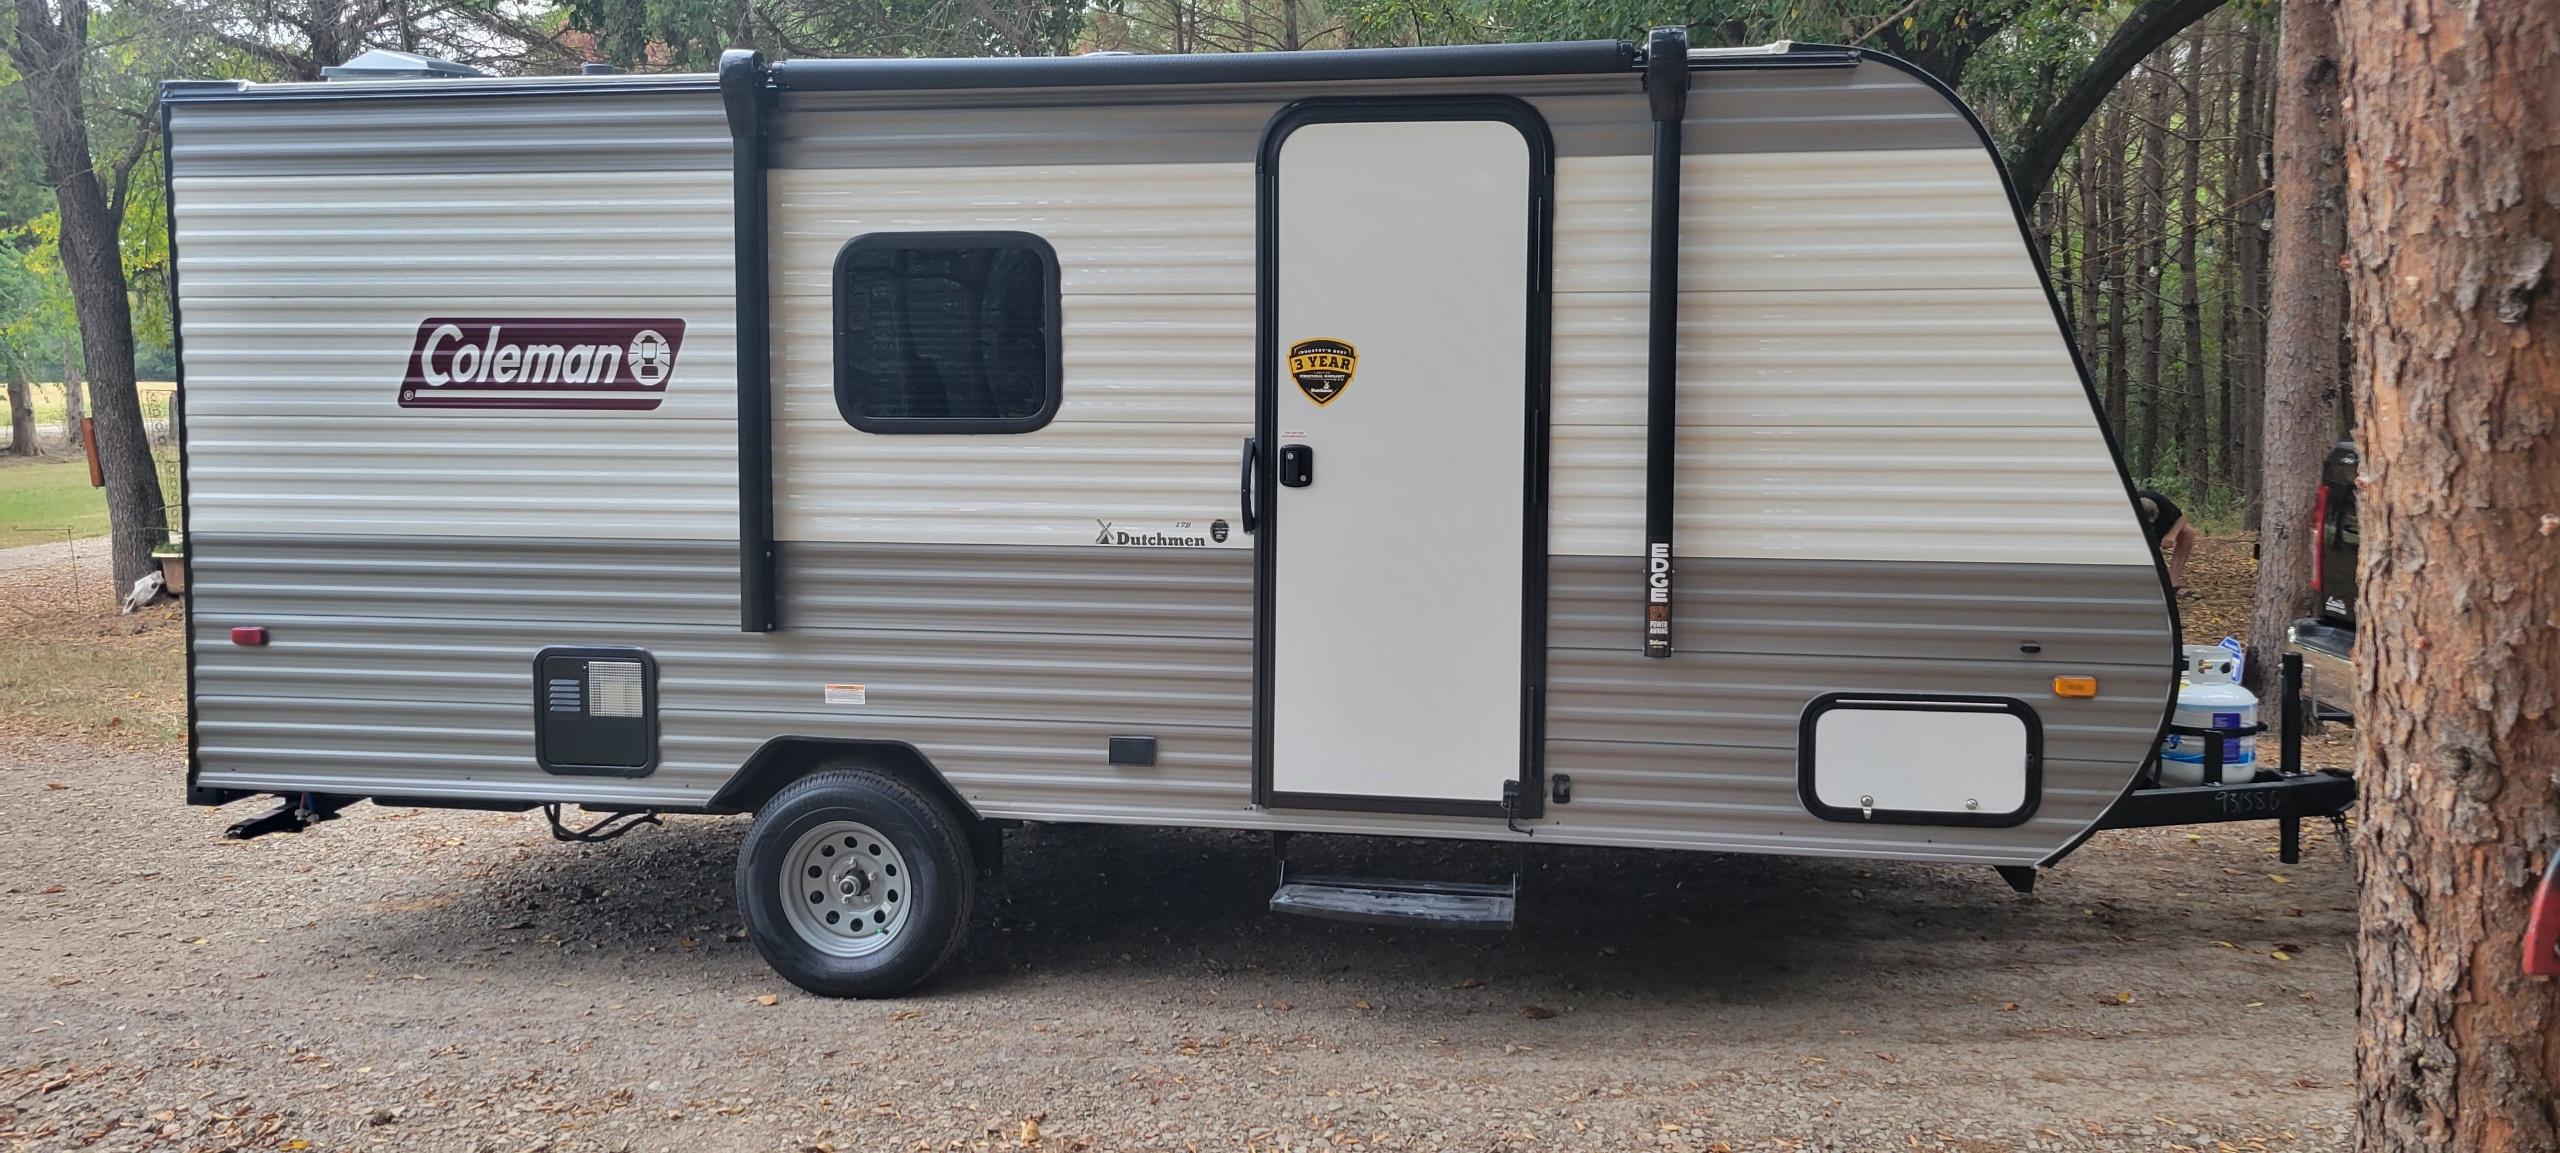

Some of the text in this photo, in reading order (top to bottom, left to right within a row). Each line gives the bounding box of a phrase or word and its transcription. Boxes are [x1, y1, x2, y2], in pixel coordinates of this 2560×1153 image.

[421, 324, 623, 386] Coleman
[1295, 355, 1351, 370] 3 YEAR
[1117, 531, 1205, 546] Dutchmen
[1650, 543, 1669, 603] EDGE
